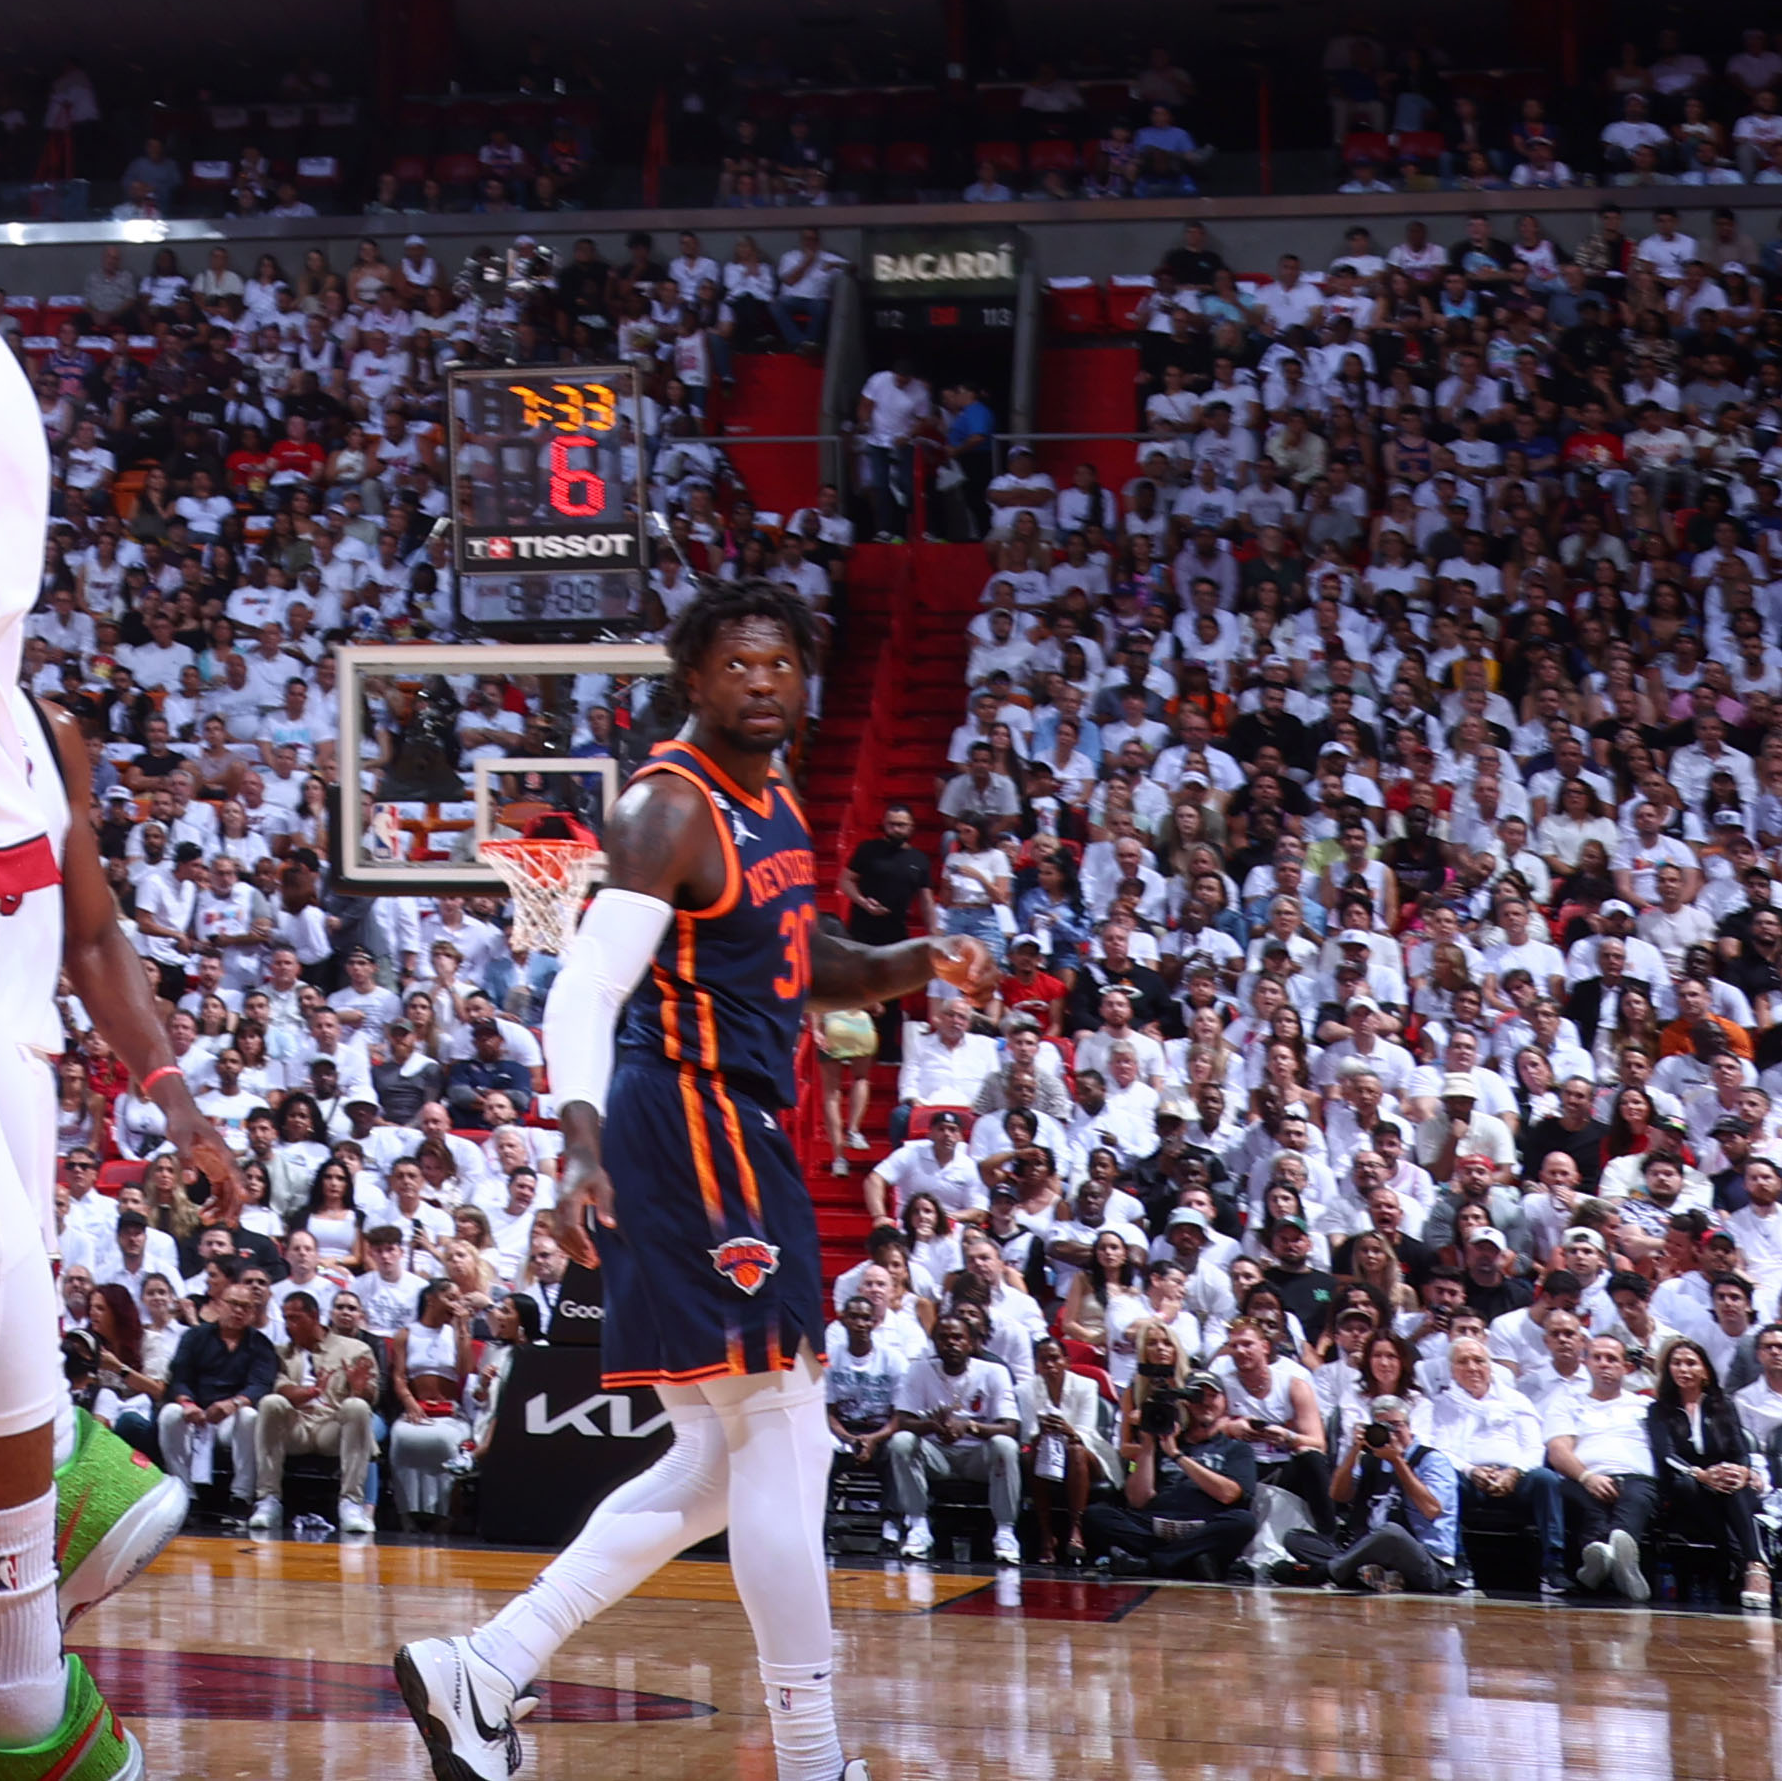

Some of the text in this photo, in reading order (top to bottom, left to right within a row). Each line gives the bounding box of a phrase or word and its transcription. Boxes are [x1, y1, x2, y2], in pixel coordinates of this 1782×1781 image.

[549, 435, 607, 517] 6
[511, 533, 636, 560] TISSOT
[559, 1299, 606, 1322] Goo
